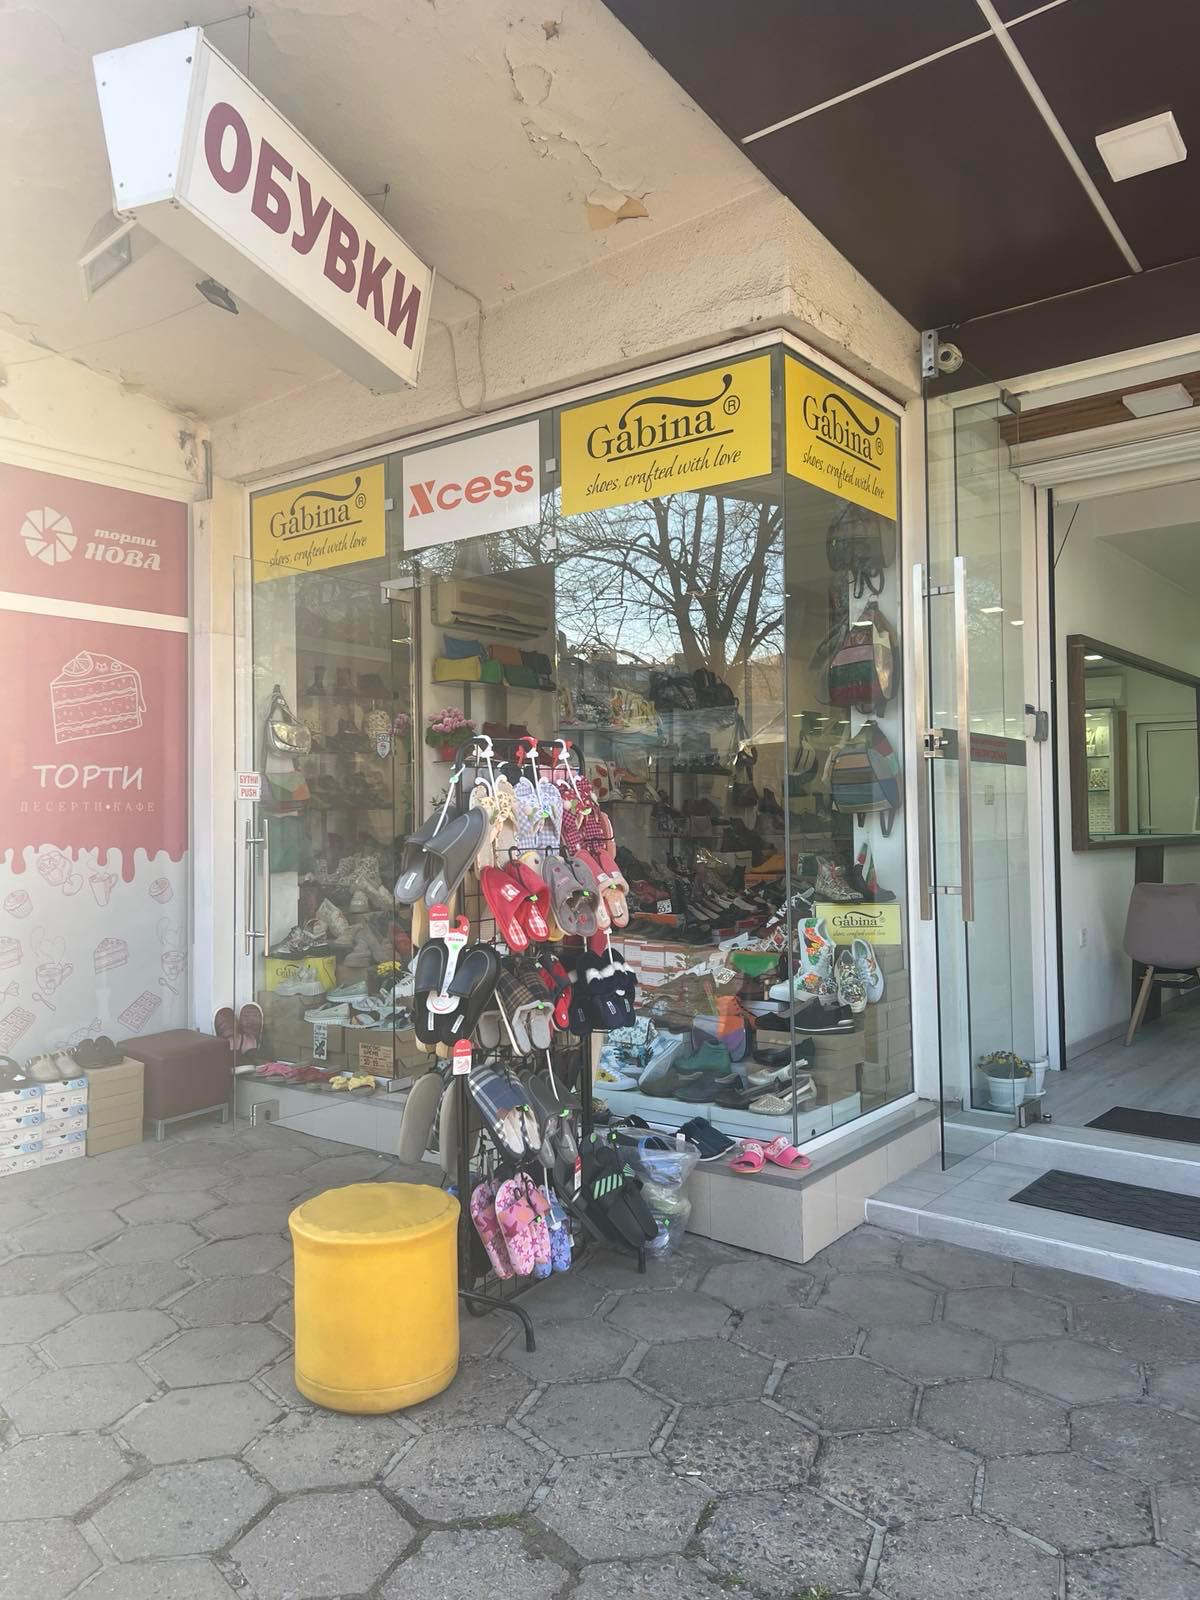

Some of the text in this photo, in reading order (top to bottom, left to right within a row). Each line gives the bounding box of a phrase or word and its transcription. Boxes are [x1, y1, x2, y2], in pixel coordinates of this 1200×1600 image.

[204, 102, 422, 350] ОБУВКИ
[587, 409, 716, 460] Gabina
[803, 395, 873, 461] Gabina
[585, 443, 742, 497] shoes, crafted with love
[826, 460, 856, 489] crafted
[854, 474, 871, 493] with
[871, 478, 885, 499] love
[408, 464, 535, 518] Xcess
[94, 528, 160, 548] торти
[269, 503, 351, 539] Gabina
[84, 542, 161, 571] НОВА
[294, 537, 328, 567] crafted
[327, 532, 348, 553] with
[349, 530, 368, 549] love
[32, 764, 143, 790] ТОРТИ
[240, 774, 259, 785] БУТНИ
[240, 787, 257, 798] PUSH
[832, 915, 878, 927] Gabina
